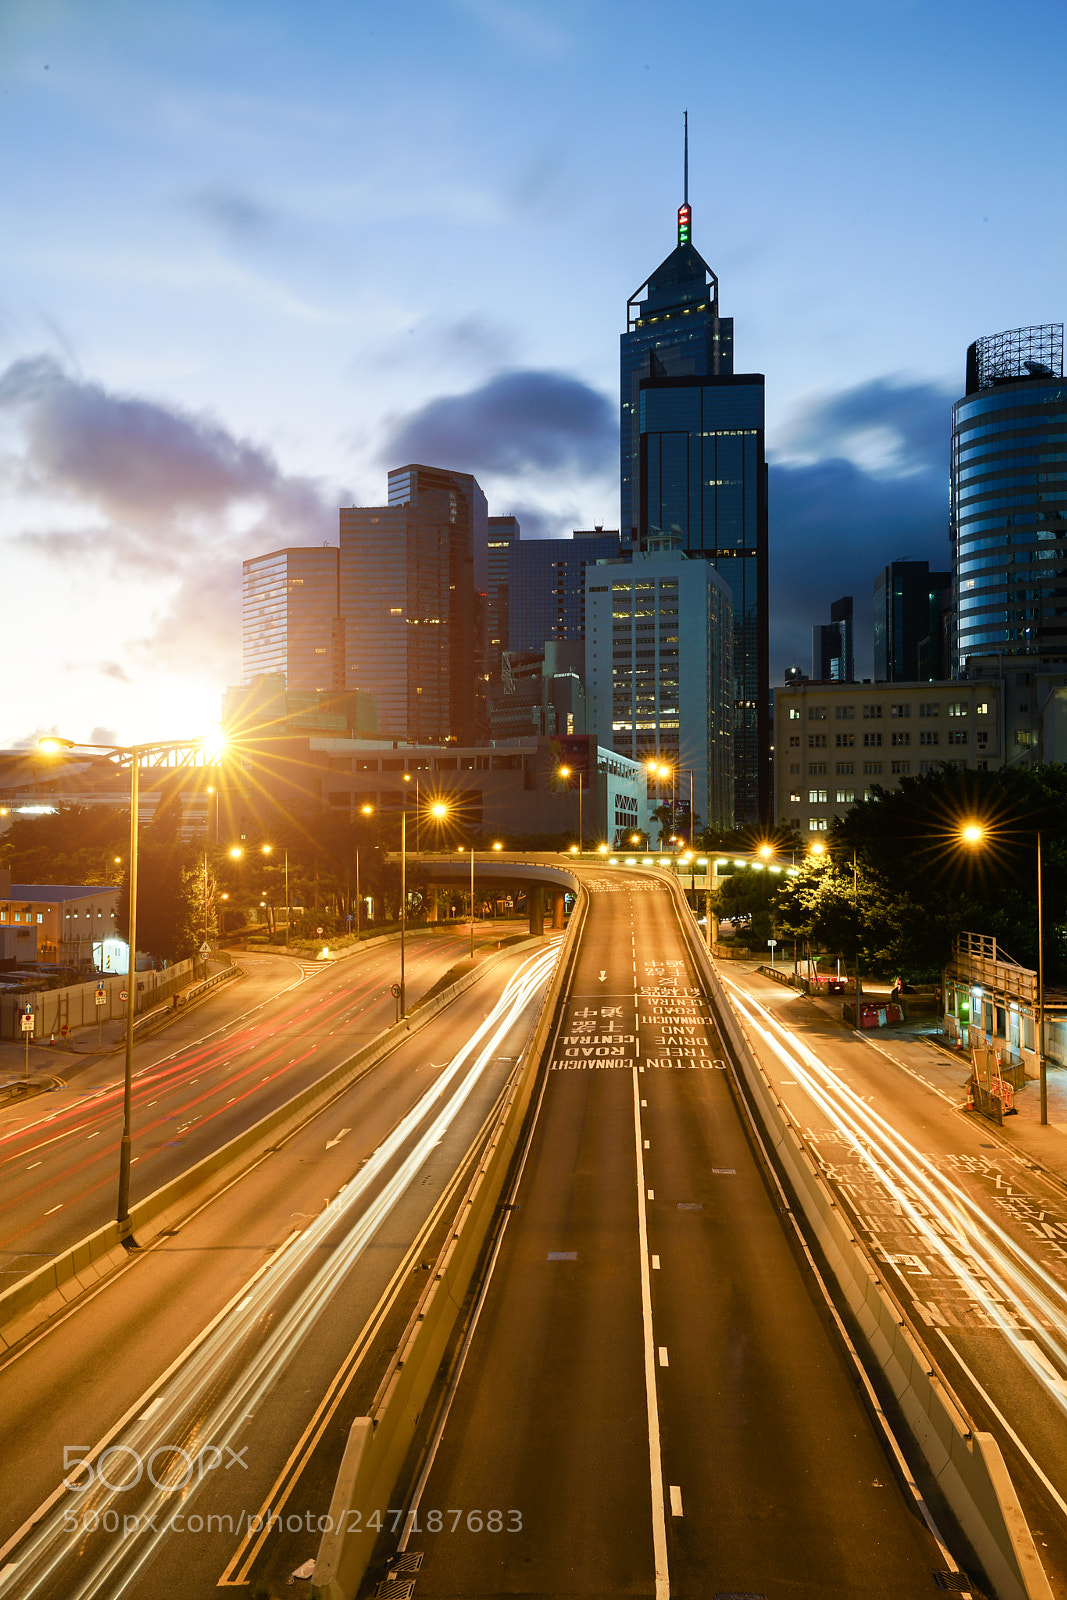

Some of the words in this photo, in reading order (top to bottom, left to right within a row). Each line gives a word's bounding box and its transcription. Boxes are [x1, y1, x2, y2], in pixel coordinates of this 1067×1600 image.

[644, 998, 703, 1006] CENTRAL
[653, 1007, 697, 1015] ROAD
[641, 1016, 713, 1025] CONNAUGHT
[661, 1026, 695, 1035] AND
[559, 1034, 635, 1045] CENTRAL
[655, 1036, 709, 1046] DRIVE
[565, 1046, 625, 1057] ROAD
[658, 1047, 709, 1057] TREE
[550, 1058, 634, 1071] CONNAUGHT
[646, 1058, 727, 1070] COTTON
